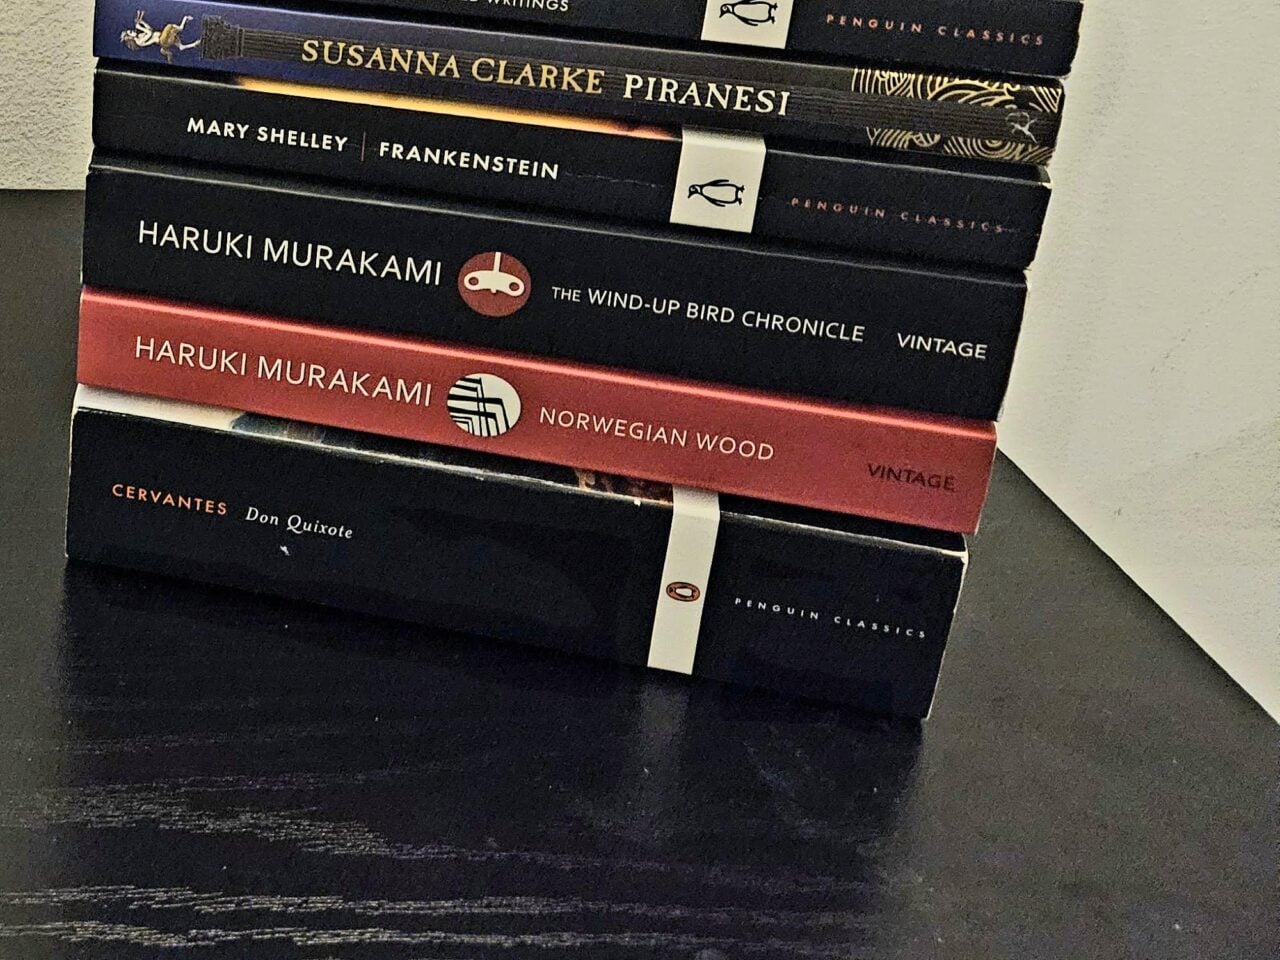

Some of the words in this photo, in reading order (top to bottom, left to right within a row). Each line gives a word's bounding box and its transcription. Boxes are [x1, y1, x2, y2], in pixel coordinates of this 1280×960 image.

[825, 13, 923, 33] PENGUIN
[937, 24, 1045, 46] CLASSICS
[301, 41, 461, 79] SUSANNA
[472, 57, 606, 94] CLARKE
[623, 74, 792, 117] PIRANESI
[187, 117, 252, 139] MARY
[257, 125, 349, 152] SHELLEY
[378, 141, 559, 180] FRANKENSTEIN
[791, 197, 885, 219] PENGUIN
[900, 211, 1004, 234] CLASSICS
[138, 219, 252, 260] HARUKI
[263, 237, 442, 287] MURAKAMI
[552, 285, 581, 302] THE
[587, 287, 680, 317] WIND-UP
[687, 302, 735, 324] BIRD
[742, 310, 865, 343] CHRONICLE
[897, 332, 987, 360] VINTAGE
[135, 335, 247, 376] HARUKI
[257, 354, 432, 407] MURAKAMI
[539, 407, 687, 448] NORWEGIAN
[696, 433, 775, 461] WOOD
[867, 462, 955, 493] VINTAGE
[112, 483, 227, 516] CERVANTES
[245, 505, 280, 527] Don
[286, 513, 354, 540] Quixote
[735, 597, 819, 620] PENGUIN
[834, 615, 926, 639] CLASSICS
